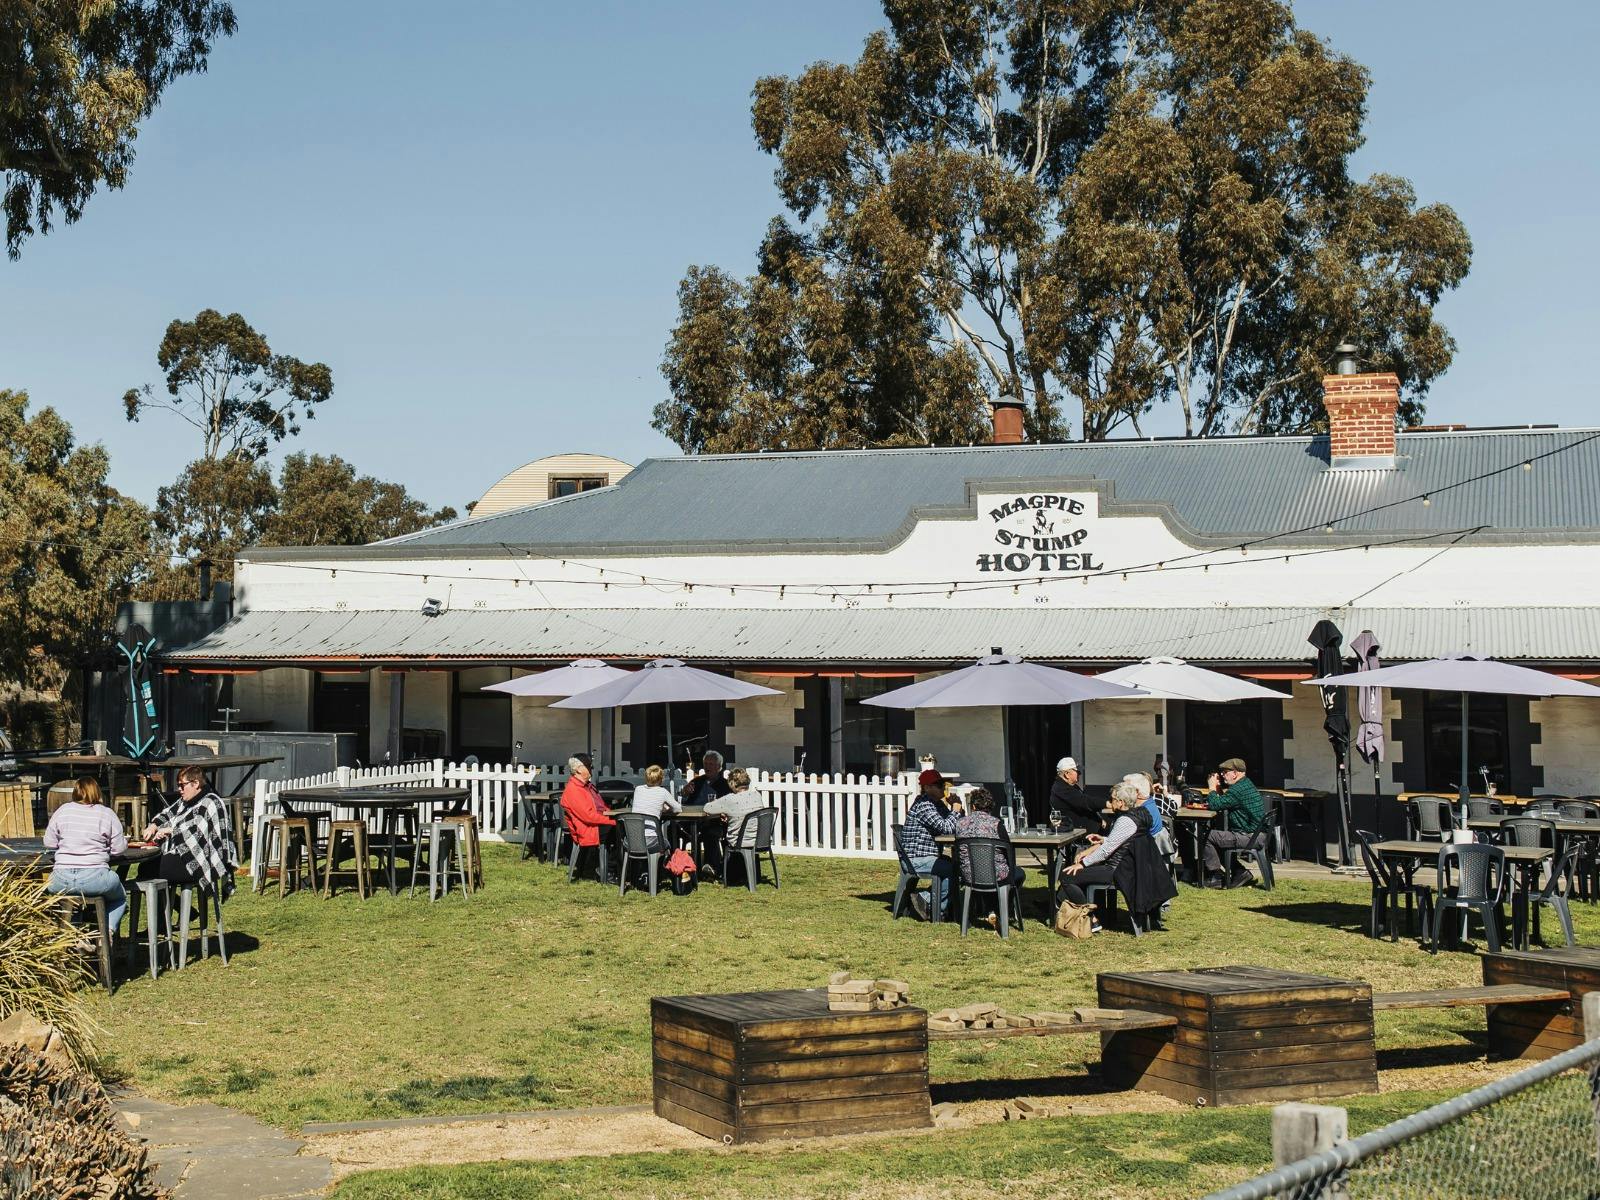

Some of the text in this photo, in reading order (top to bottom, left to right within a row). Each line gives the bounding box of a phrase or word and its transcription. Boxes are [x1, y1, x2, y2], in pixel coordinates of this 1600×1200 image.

[989, 495, 1084, 523] MAGPIE
[995, 528, 1088, 551] STUMP
[976, 552, 1104, 572] HOTEL
